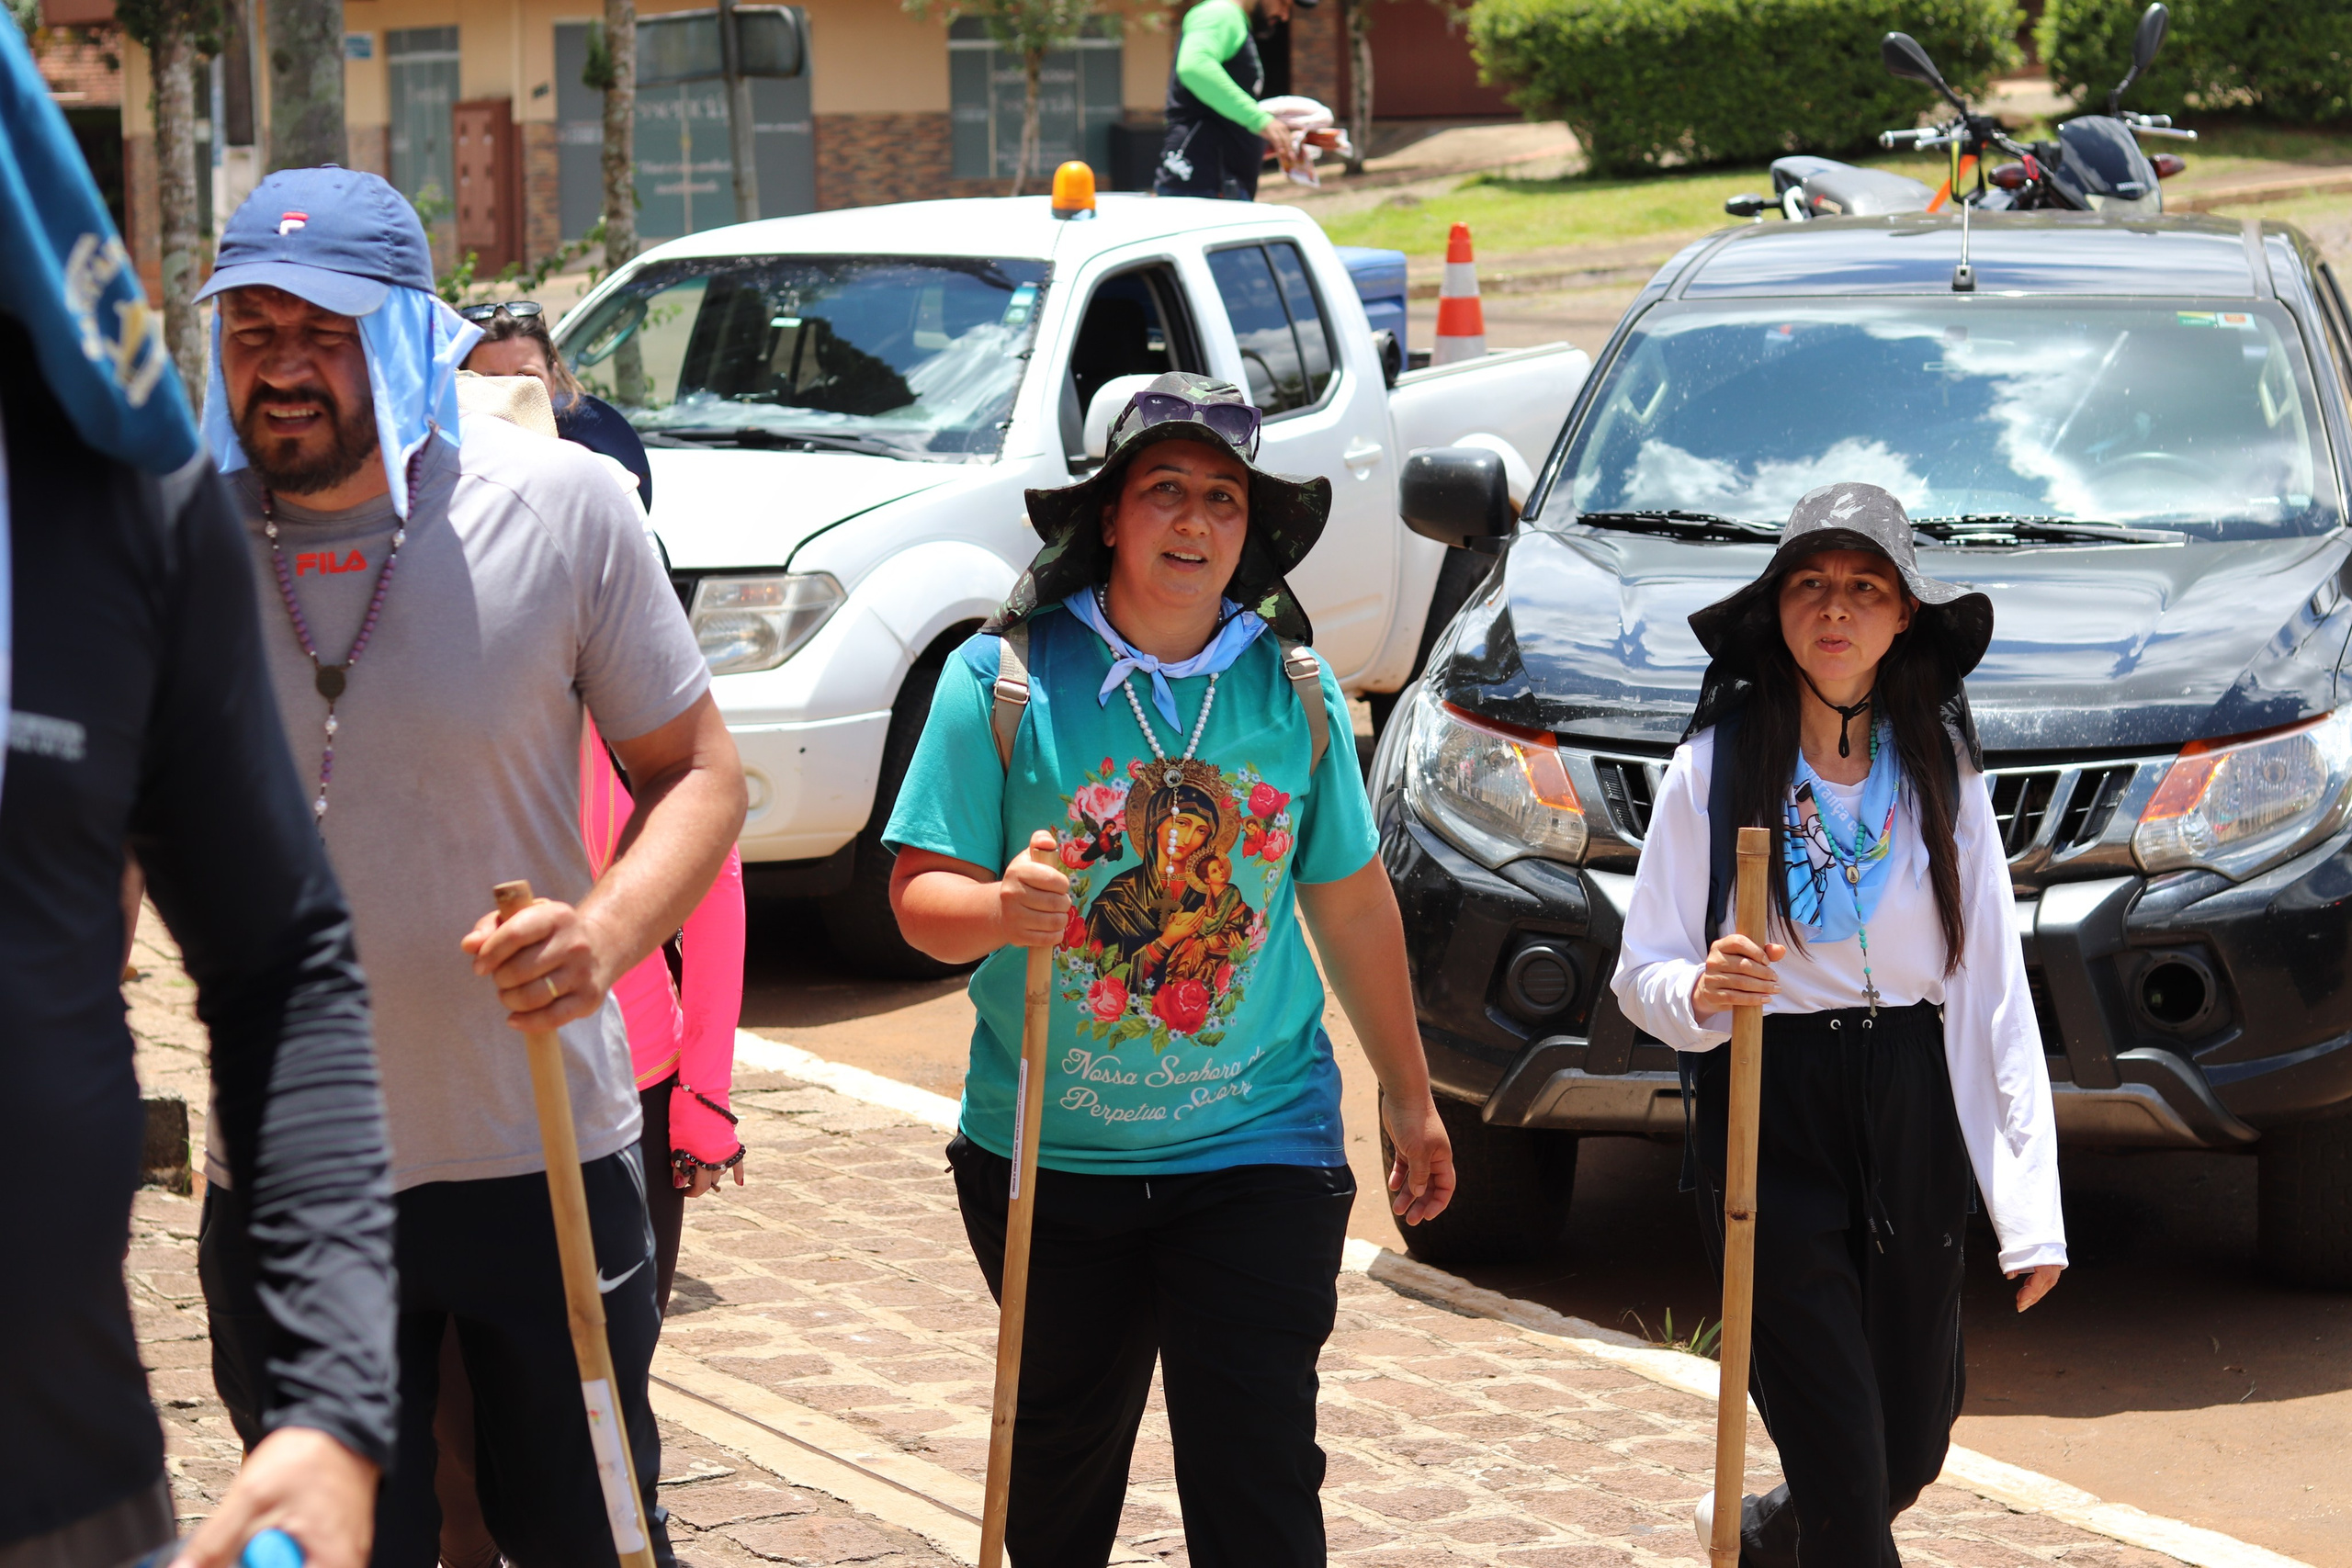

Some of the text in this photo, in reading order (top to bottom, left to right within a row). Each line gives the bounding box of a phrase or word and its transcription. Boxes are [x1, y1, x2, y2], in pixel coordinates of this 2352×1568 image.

[296, 549, 367, 577] FILA
[1061, 1048, 1137, 1085] Nossa
[1145, 1055, 1242, 1087] Senhora
[1059, 1087, 1167, 1125] Perpetuo
